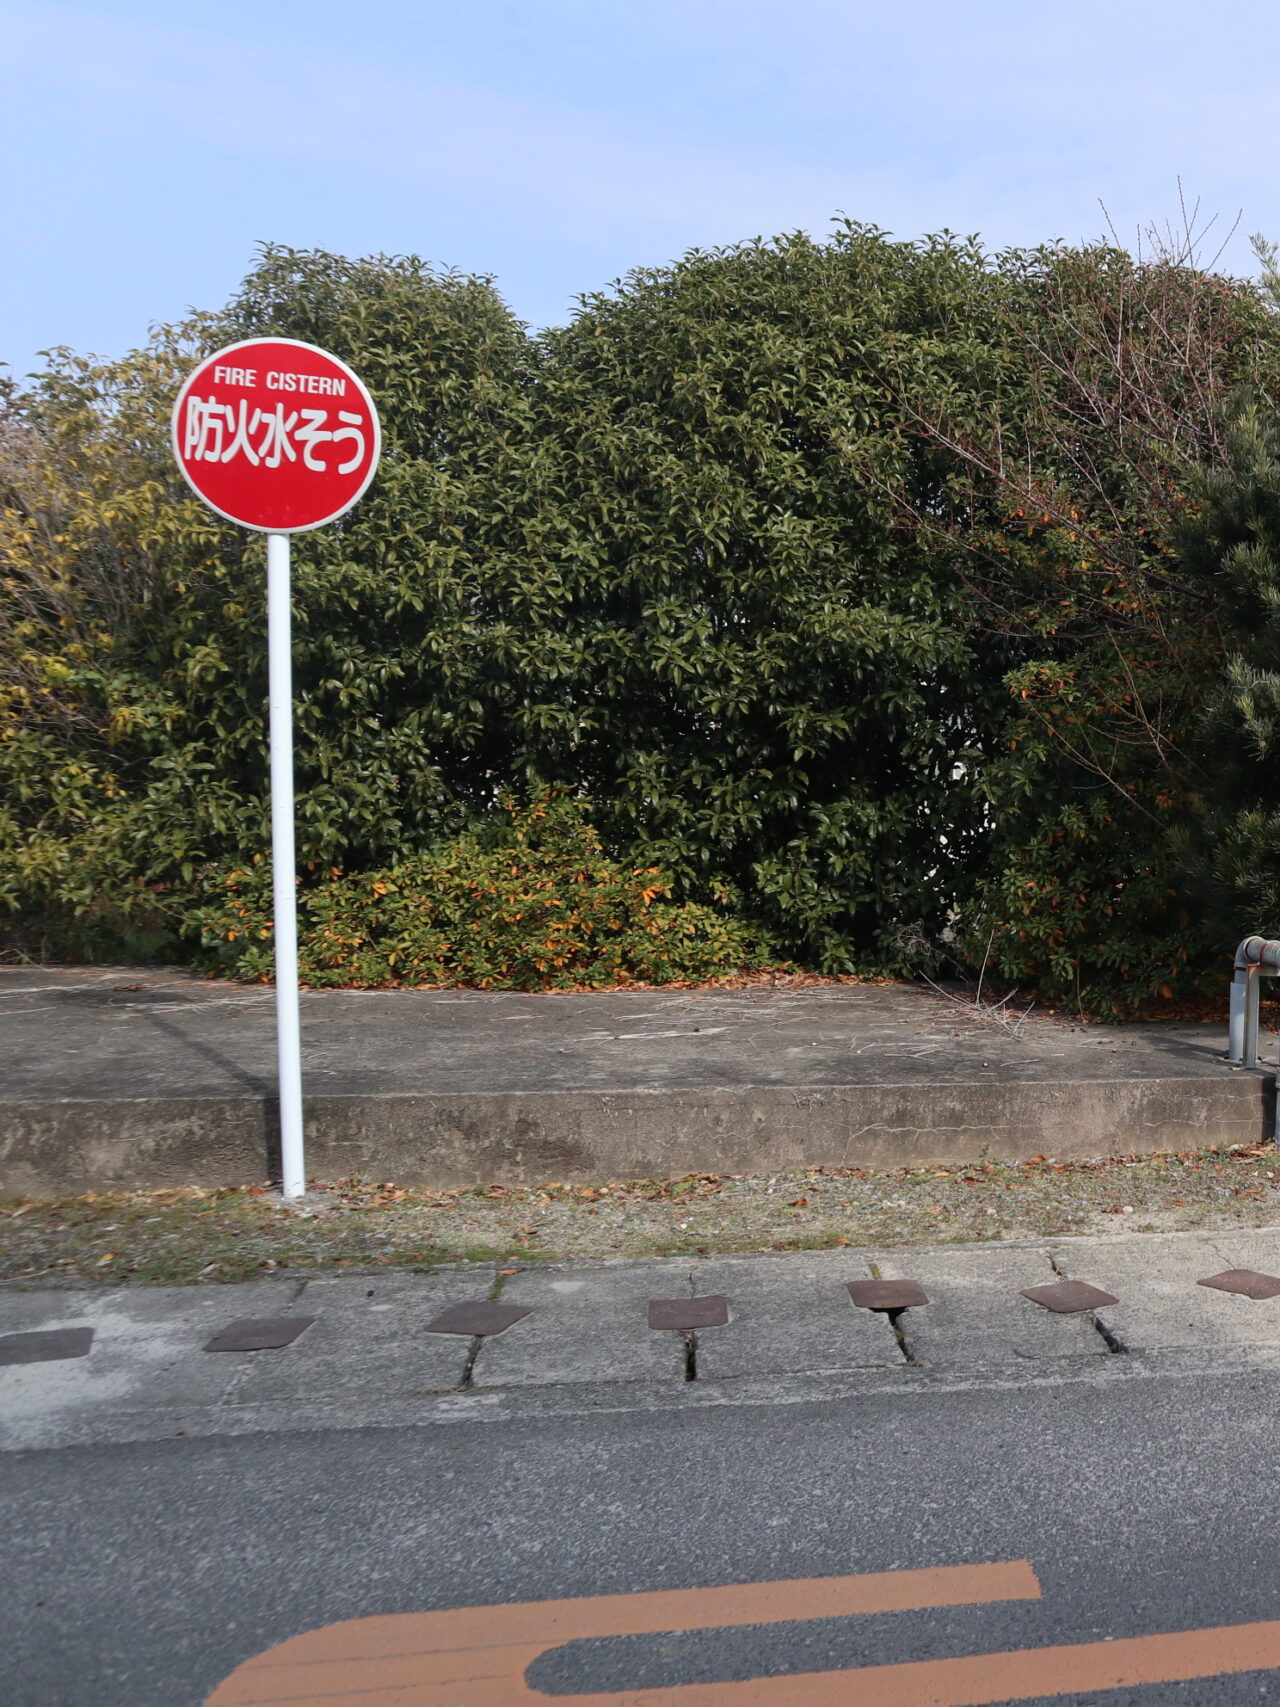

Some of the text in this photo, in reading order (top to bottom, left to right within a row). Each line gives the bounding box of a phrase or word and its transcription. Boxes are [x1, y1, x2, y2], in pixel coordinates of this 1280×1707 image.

[214, 366, 346, 396] FIRE CISTERN
[184, 395, 365, 475] 防火水そう
